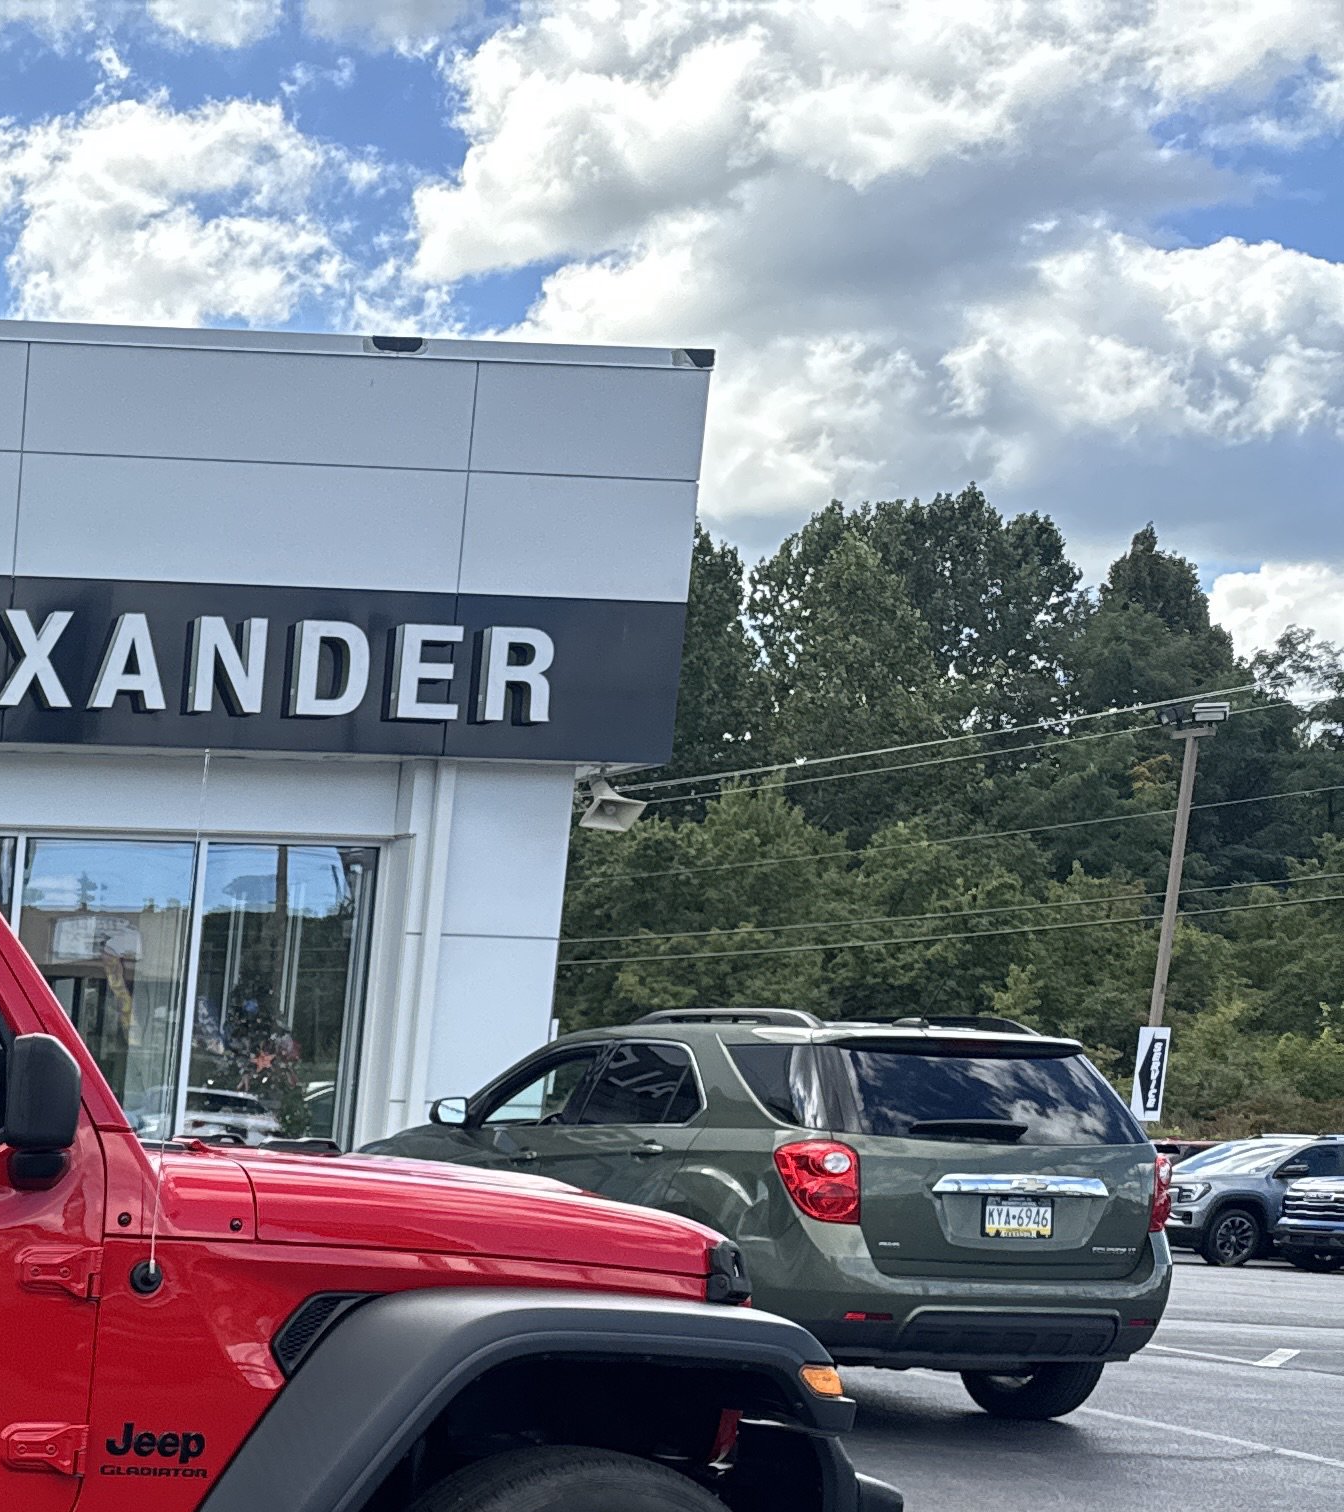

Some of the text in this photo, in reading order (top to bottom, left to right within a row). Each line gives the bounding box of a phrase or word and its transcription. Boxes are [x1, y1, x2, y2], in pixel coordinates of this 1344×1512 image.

[1146, 1041, 1163, 1108] SERVICE
[105, 1422, 205, 1464] Jeep
[99, 1465, 208, 1478] GLADIATOR
